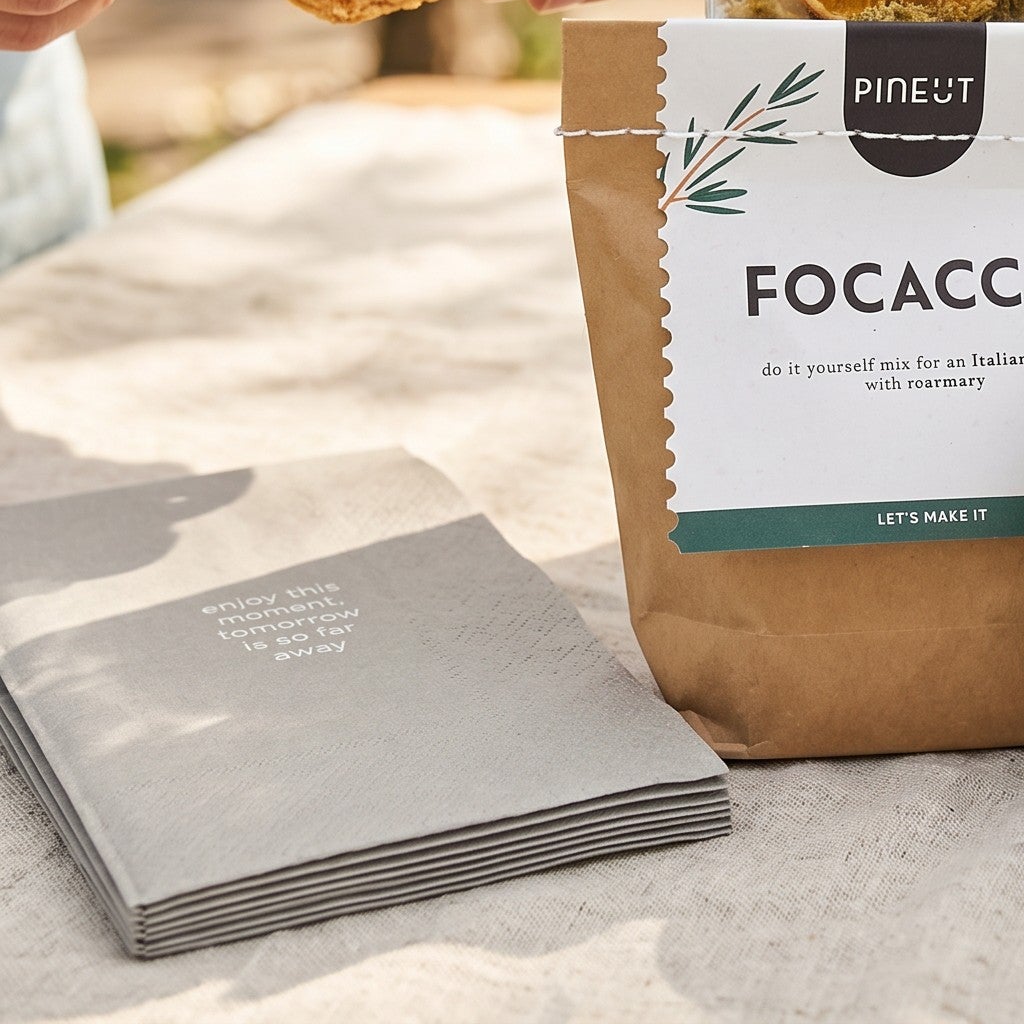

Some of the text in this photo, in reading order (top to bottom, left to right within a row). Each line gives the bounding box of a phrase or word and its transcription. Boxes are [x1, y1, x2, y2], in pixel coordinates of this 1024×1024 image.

[853, 76, 975, 105] PINEUT
[762, 362, 782, 377] do
[788, 361, 801, 376] it
[806, 358, 876, 378] yourself
[880, 357, 911, 372] mix
[916, 355, 940, 370] for
[947, 357, 966, 369] an
[865, 375, 986, 391] with roarmary
[877, 507, 988, 527] LET'S MAKE IT
[201, 582, 341, 614] enjoy this
[217, 596, 345, 626] moment.
[217, 608, 360, 640] tomorrow
[242, 623, 355, 652] is so far
[273, 640, 346, 661] away
